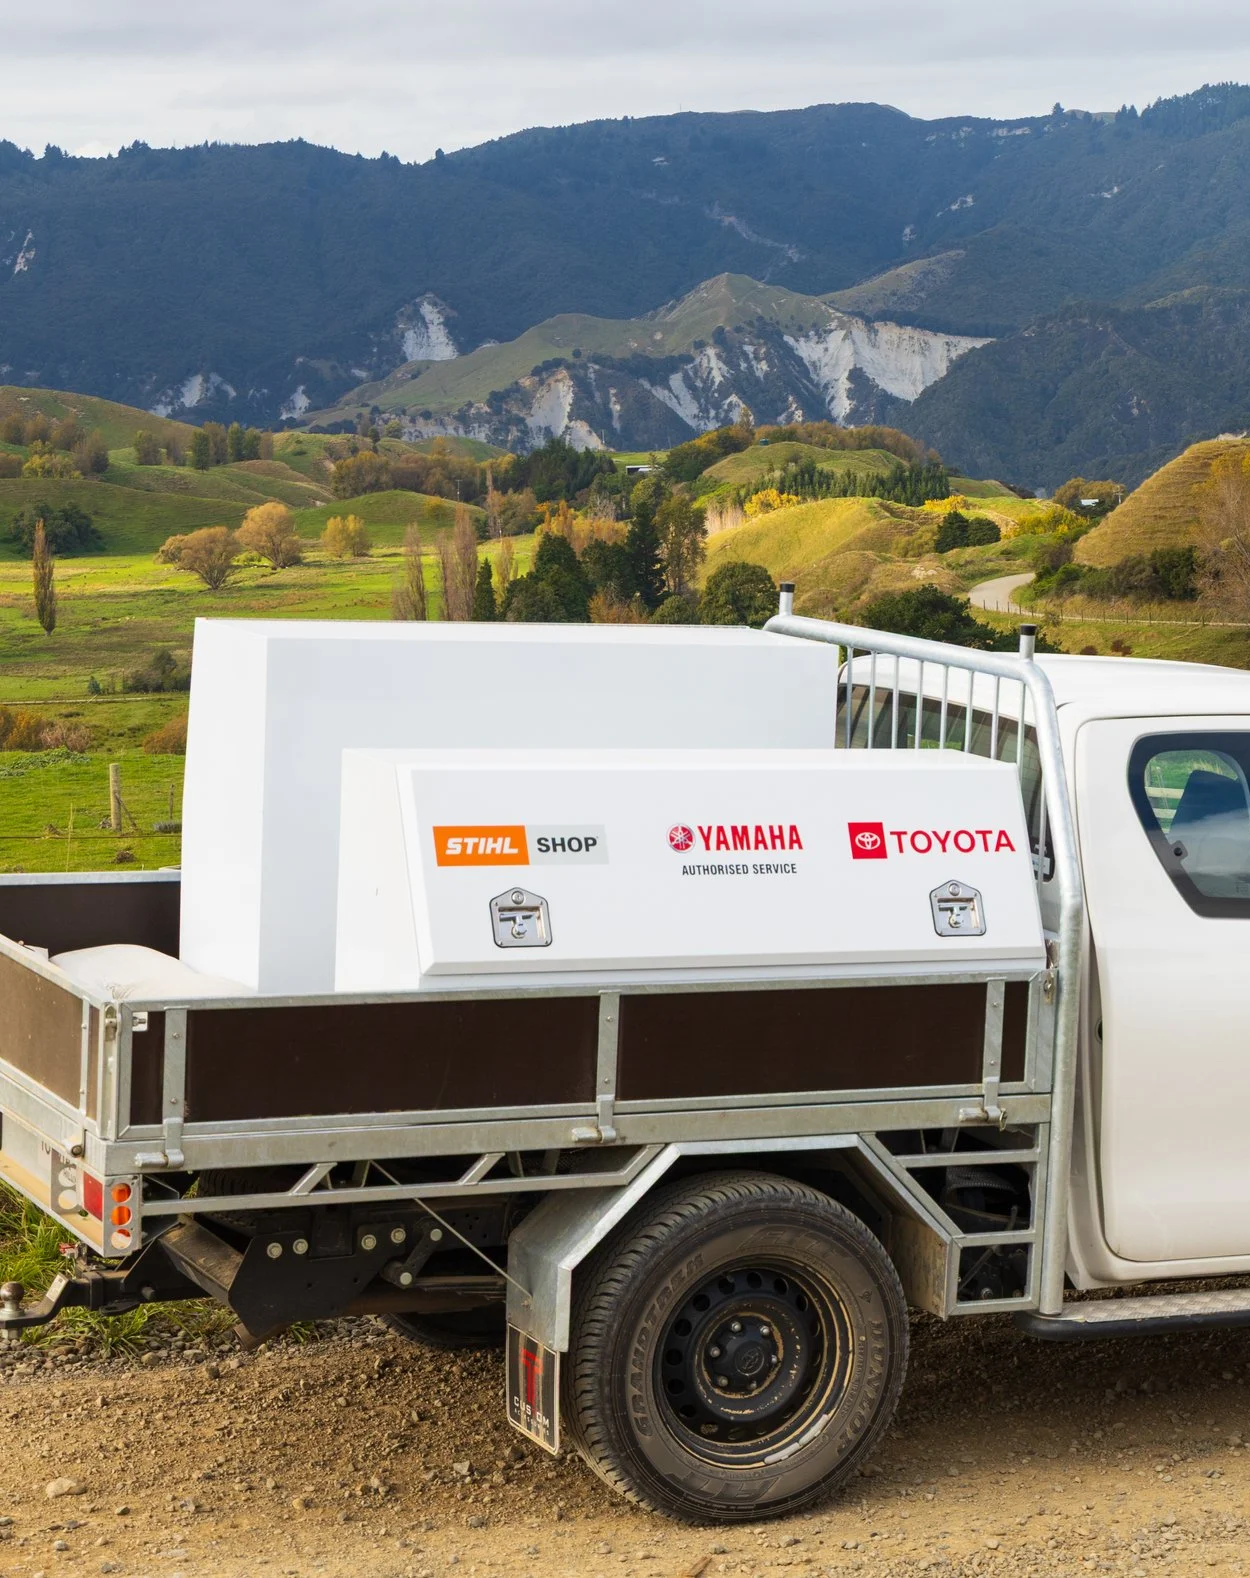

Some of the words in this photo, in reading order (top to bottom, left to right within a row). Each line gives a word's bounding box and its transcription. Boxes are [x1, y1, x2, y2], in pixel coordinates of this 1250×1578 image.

[445, 837, 519, 855] STIHL
[537, 836, 598, 853] SHOP
[697, 825, 804, 851] YAMAHA
[890, 829, 1016, 854] TOYOTA
[682, 864, 749, 876] AUTHORISED
[752, 863, 797, 875] SERVICE
